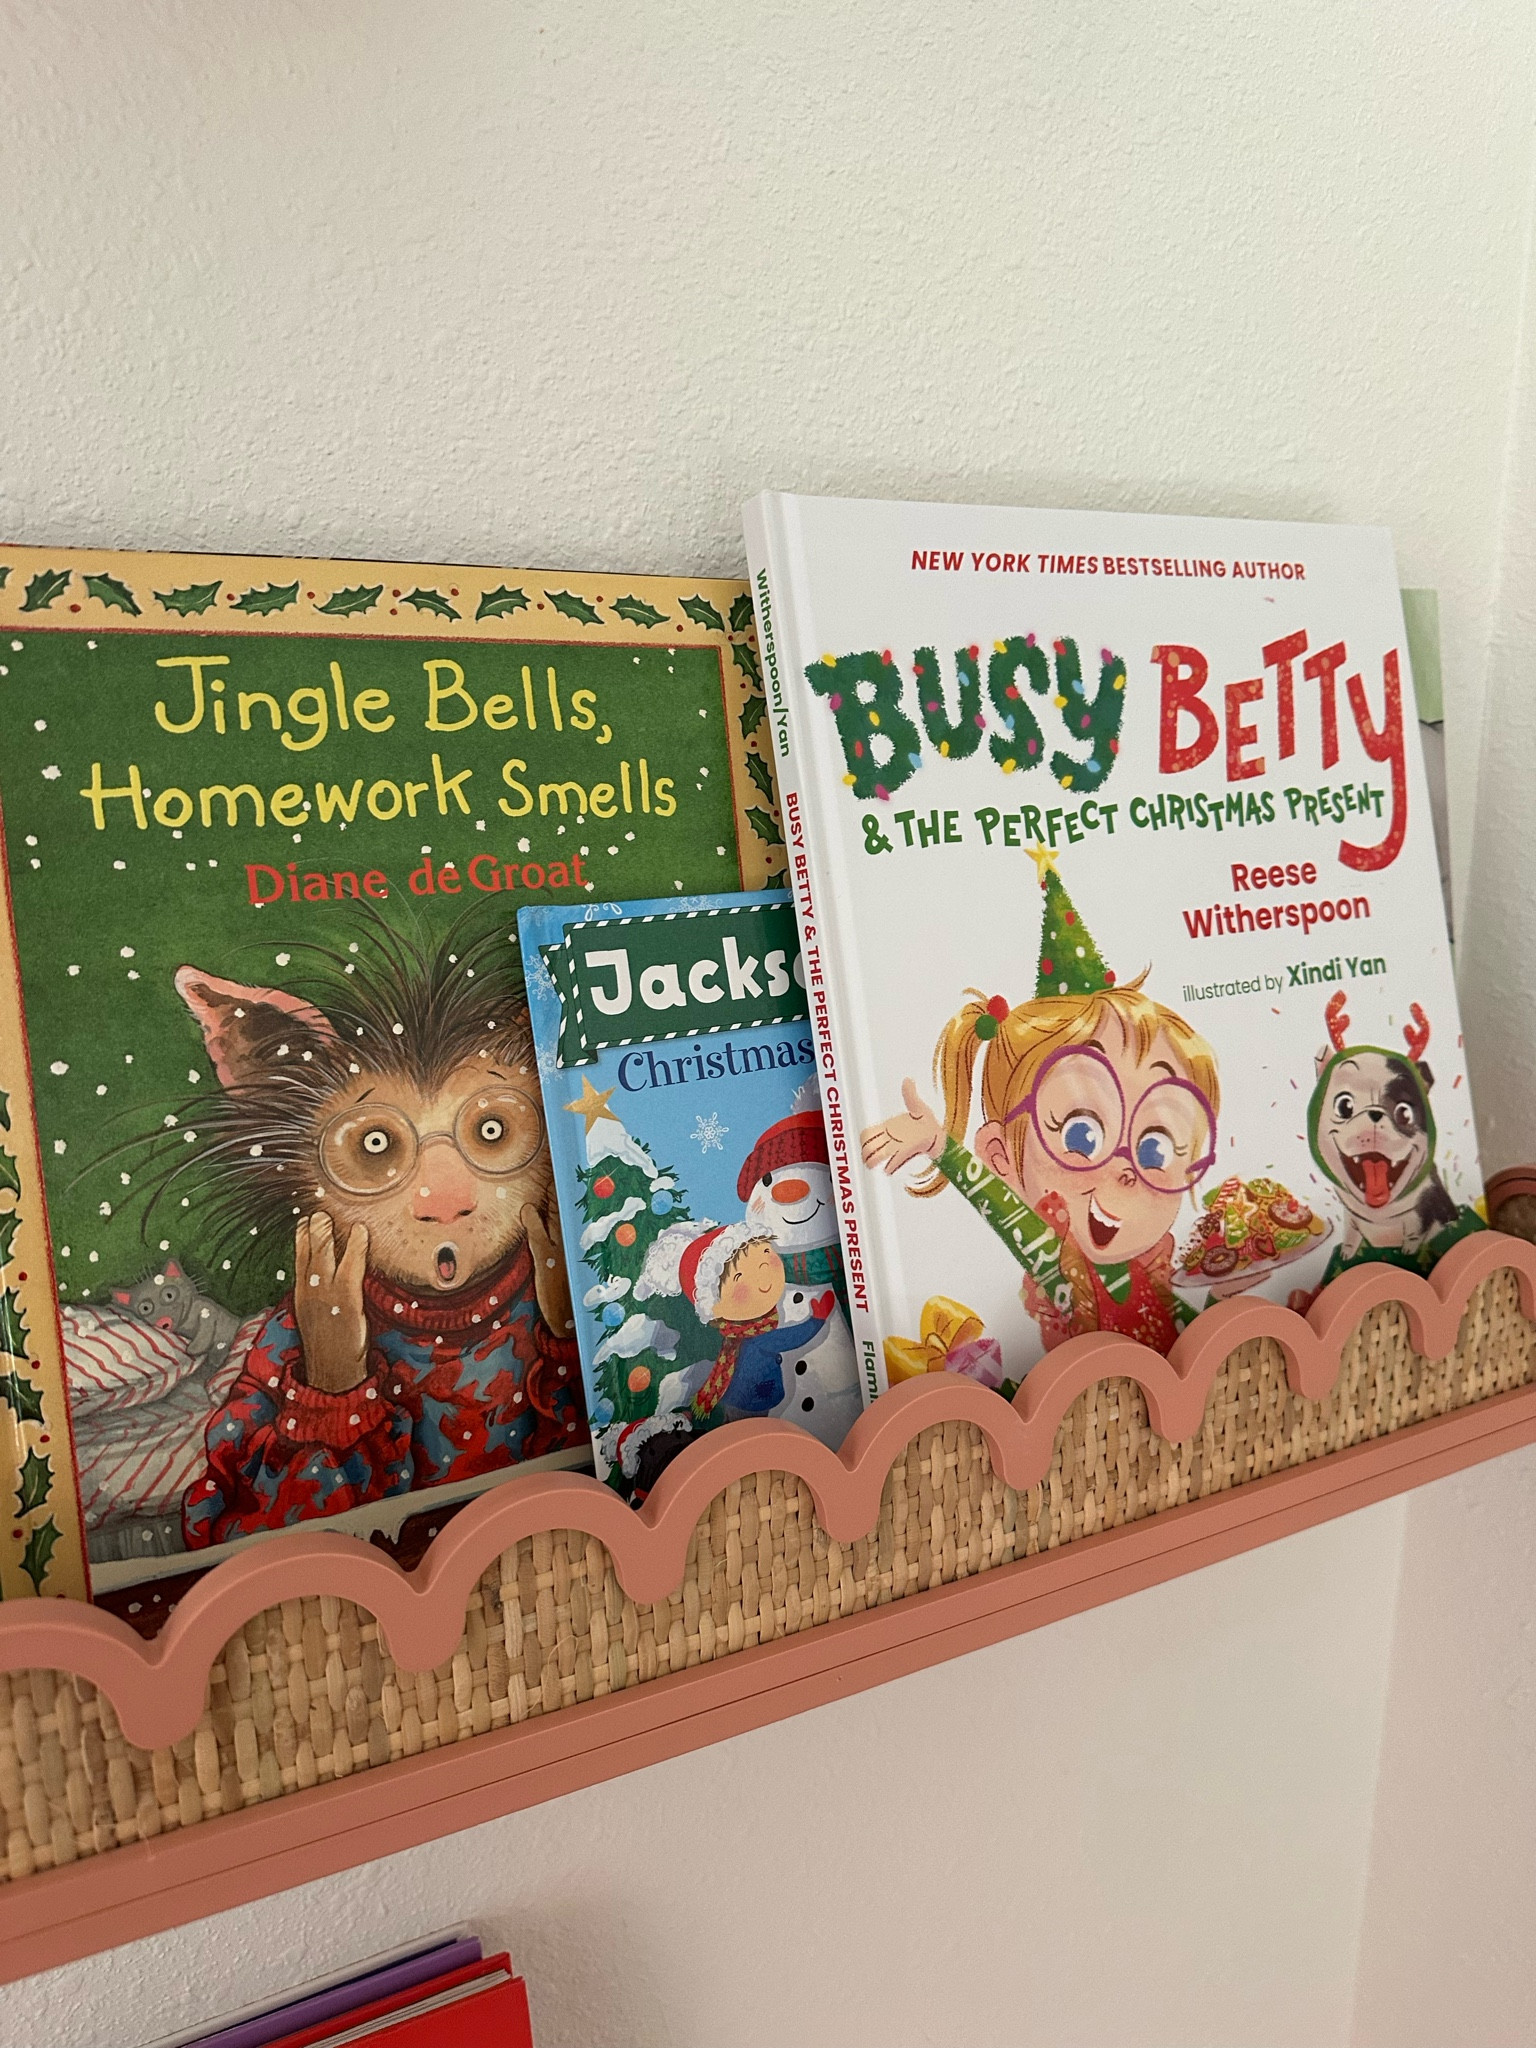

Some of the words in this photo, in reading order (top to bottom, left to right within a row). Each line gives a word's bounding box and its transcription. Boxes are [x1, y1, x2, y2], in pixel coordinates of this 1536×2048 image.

[911, 550, 964, 571] NEW
[970, 552, 1031, 573] YORK
[1037, 554, 1099, 575] TIMES
[1103, 556, 1227, 578] BESTSELLING
[1231, 561, 1306, 581] AUTHOR
[155, 656, 395, 751] Jingle
[424, 660, 613, 744] Bells,
[804, 632, 1127, 801] BUSY
[80, 753, 474, 830] Homework
[499, 758, 678, 818] Smells
[861, 812, 894, 855] &
[894, 809, 963, 849] THE
[974, 802, 1120, 848] PERFECT
[1129, 791, 1275, 832] CHRISTMAS
[1283, 782, 1386, 827] PRESENT
[786, 792, 805, 849] BUSY
[245, 864, 389, 905] Diane
[408, 858, 462, 895] de
[467, 853, 588, 893] Groat
[794, 853, 815, 919] BETTY
[1231, 862, 1318, 893] Reese
[804, 925, 817, 943] &
[1182, 896, 1371, 939] Witherspoon
[807, 945, 824, 987] THE
[1183, 975, 1261, 1002] illustrated
[1264, 974, 1284, 994] by
[1286, 956, 1343, 988] Xindi
[1345, 956, 1387, 978] Yan
[617, 1037, 817, 1092] Christmas
[813, 990, 837, 1082] PERFECT
[826, 1086, 855, 1214] CHRISTMAS
[844, 1219, 869, 1313] PRESENT
